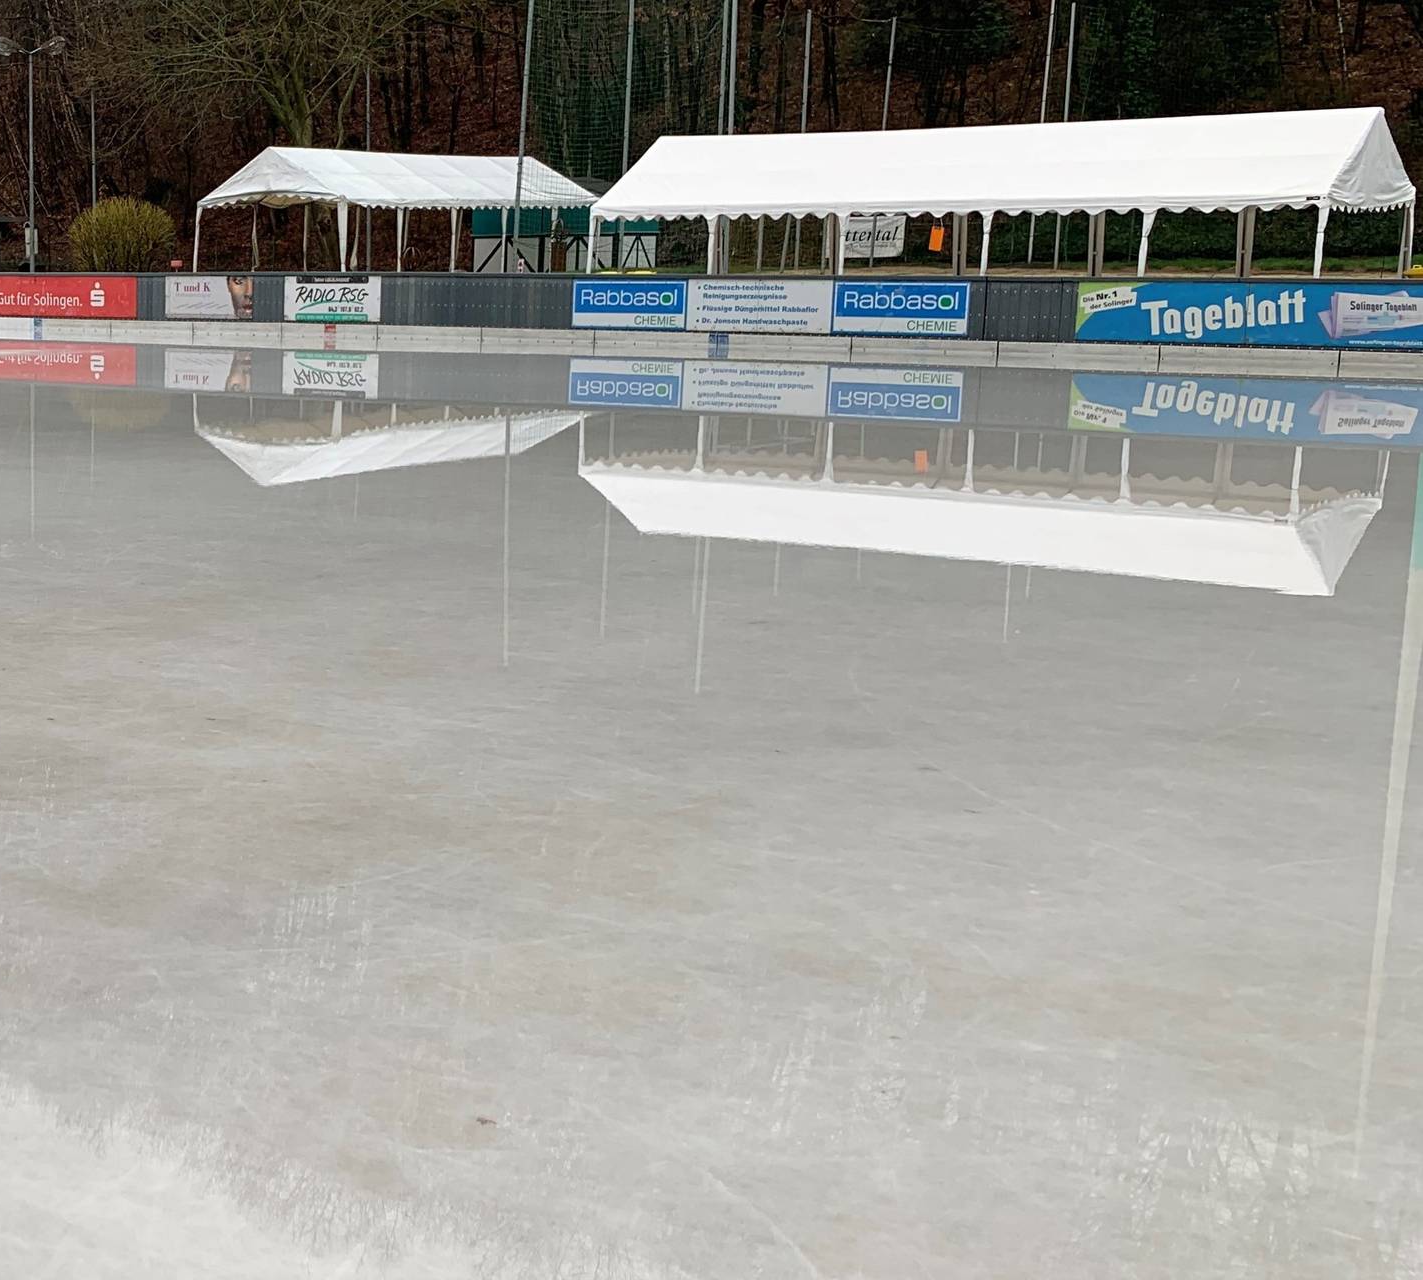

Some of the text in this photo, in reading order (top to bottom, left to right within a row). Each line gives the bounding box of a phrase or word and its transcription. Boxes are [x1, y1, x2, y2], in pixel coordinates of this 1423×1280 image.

[845, 226, 898, 241] ttertal
[183, 282, 200, 292] und
[203, 282, 211, 292] K
[295, 286, 369, 303] RADIO RSG
[581, 289, 678, 306] Rabbasol
[1096, 292, 1111, 300] Nr.
[1112, 290, 1118, 298] 1
[16, 292, 32, 306] für
[33, 293, 83, 309] Solingen.
[843, 291, 959, 310] Rabbasol
[1103, 299, 1133, 308] Solinger
[734, 305, 780, 313] Düngemittel
[1350, 301, 1417, 312] Solinger Tageblatt
[1140, 289, 1306, 339] Tageblatt
[634, 315, 677, 326] CHEMIE
[742, 318, 808, 326] Handwaschpaste
[906, 320, 957, 331] CHEMIE
